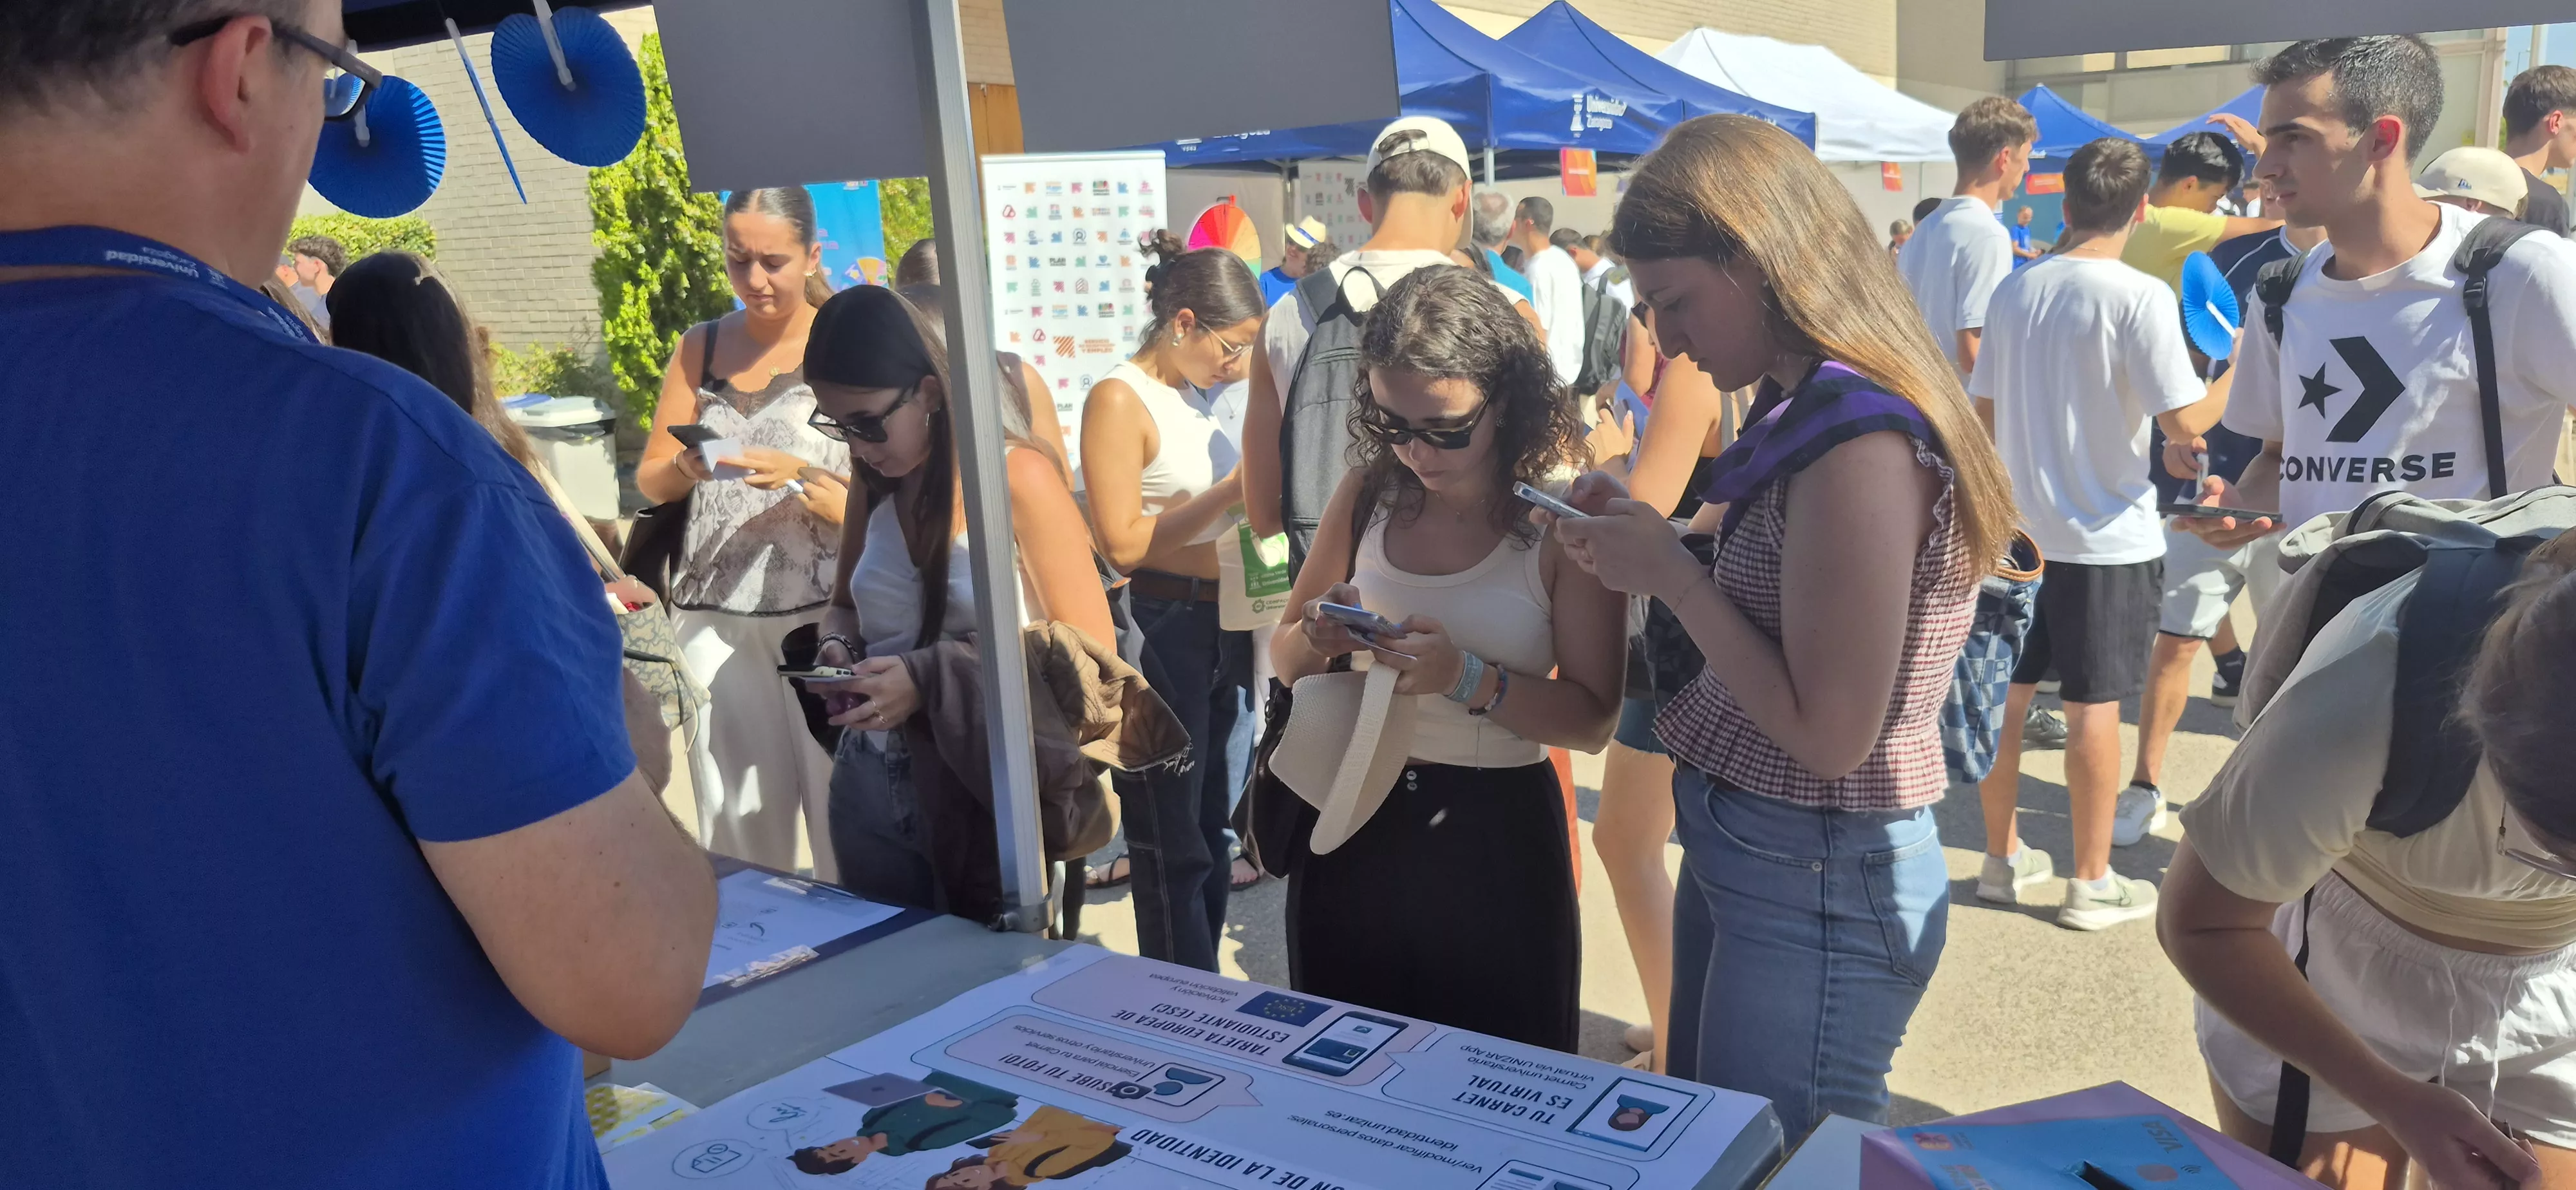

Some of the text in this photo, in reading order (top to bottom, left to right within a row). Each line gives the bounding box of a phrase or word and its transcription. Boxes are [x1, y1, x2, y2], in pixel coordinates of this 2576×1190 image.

[105, 250, 199, 278] Universidad
[1180, 987, 1231, 1003] Activación
[1014, 1025, 1055, 1040] servicios
[1150, 1003, 1291, 1043] ESTUDIANTE (ESC)
[1056, 1036, 1084, 1048] otros
[1111, 1010, 1271, 1056] TARJETA EUROPEA DE
[1025, 1041, 1061, 1055] Carnet
[1089, 1046, 1156, 1068] Universitario
[1460, 1044, 1486, 1056] App
[998, 1053, 1048, 1072] FOTO!
[1072, 1053, 1097, 1066] para
[1095, 1060, 1141, 1077] Esencial
[1485, 1051, 1534, 1068] UNIZAR
[1044, 1066, 1069, 1079] TU
[1468, 1056, 1587, 1090] Carnet universitario
[1554, 1068, 1595, 1081] virtual
[1468, 1074, 1574, 1110] ES VIRTUAL
[1452, 1091, 1556, 1124] TU CARNET
[1324, 1110, 1459, 1151] identidad.unizar.es
[2143, 1122, 2184, 1154] VISA
[1130, 1129, 1245, 1170] IDENTIDAD
[1287, 1114, 1482, 1173] Ver/modificar datos personales:
[1242, 1161, 1276, 1180] LA
[1272, 1171, 1310, 1190] DE
